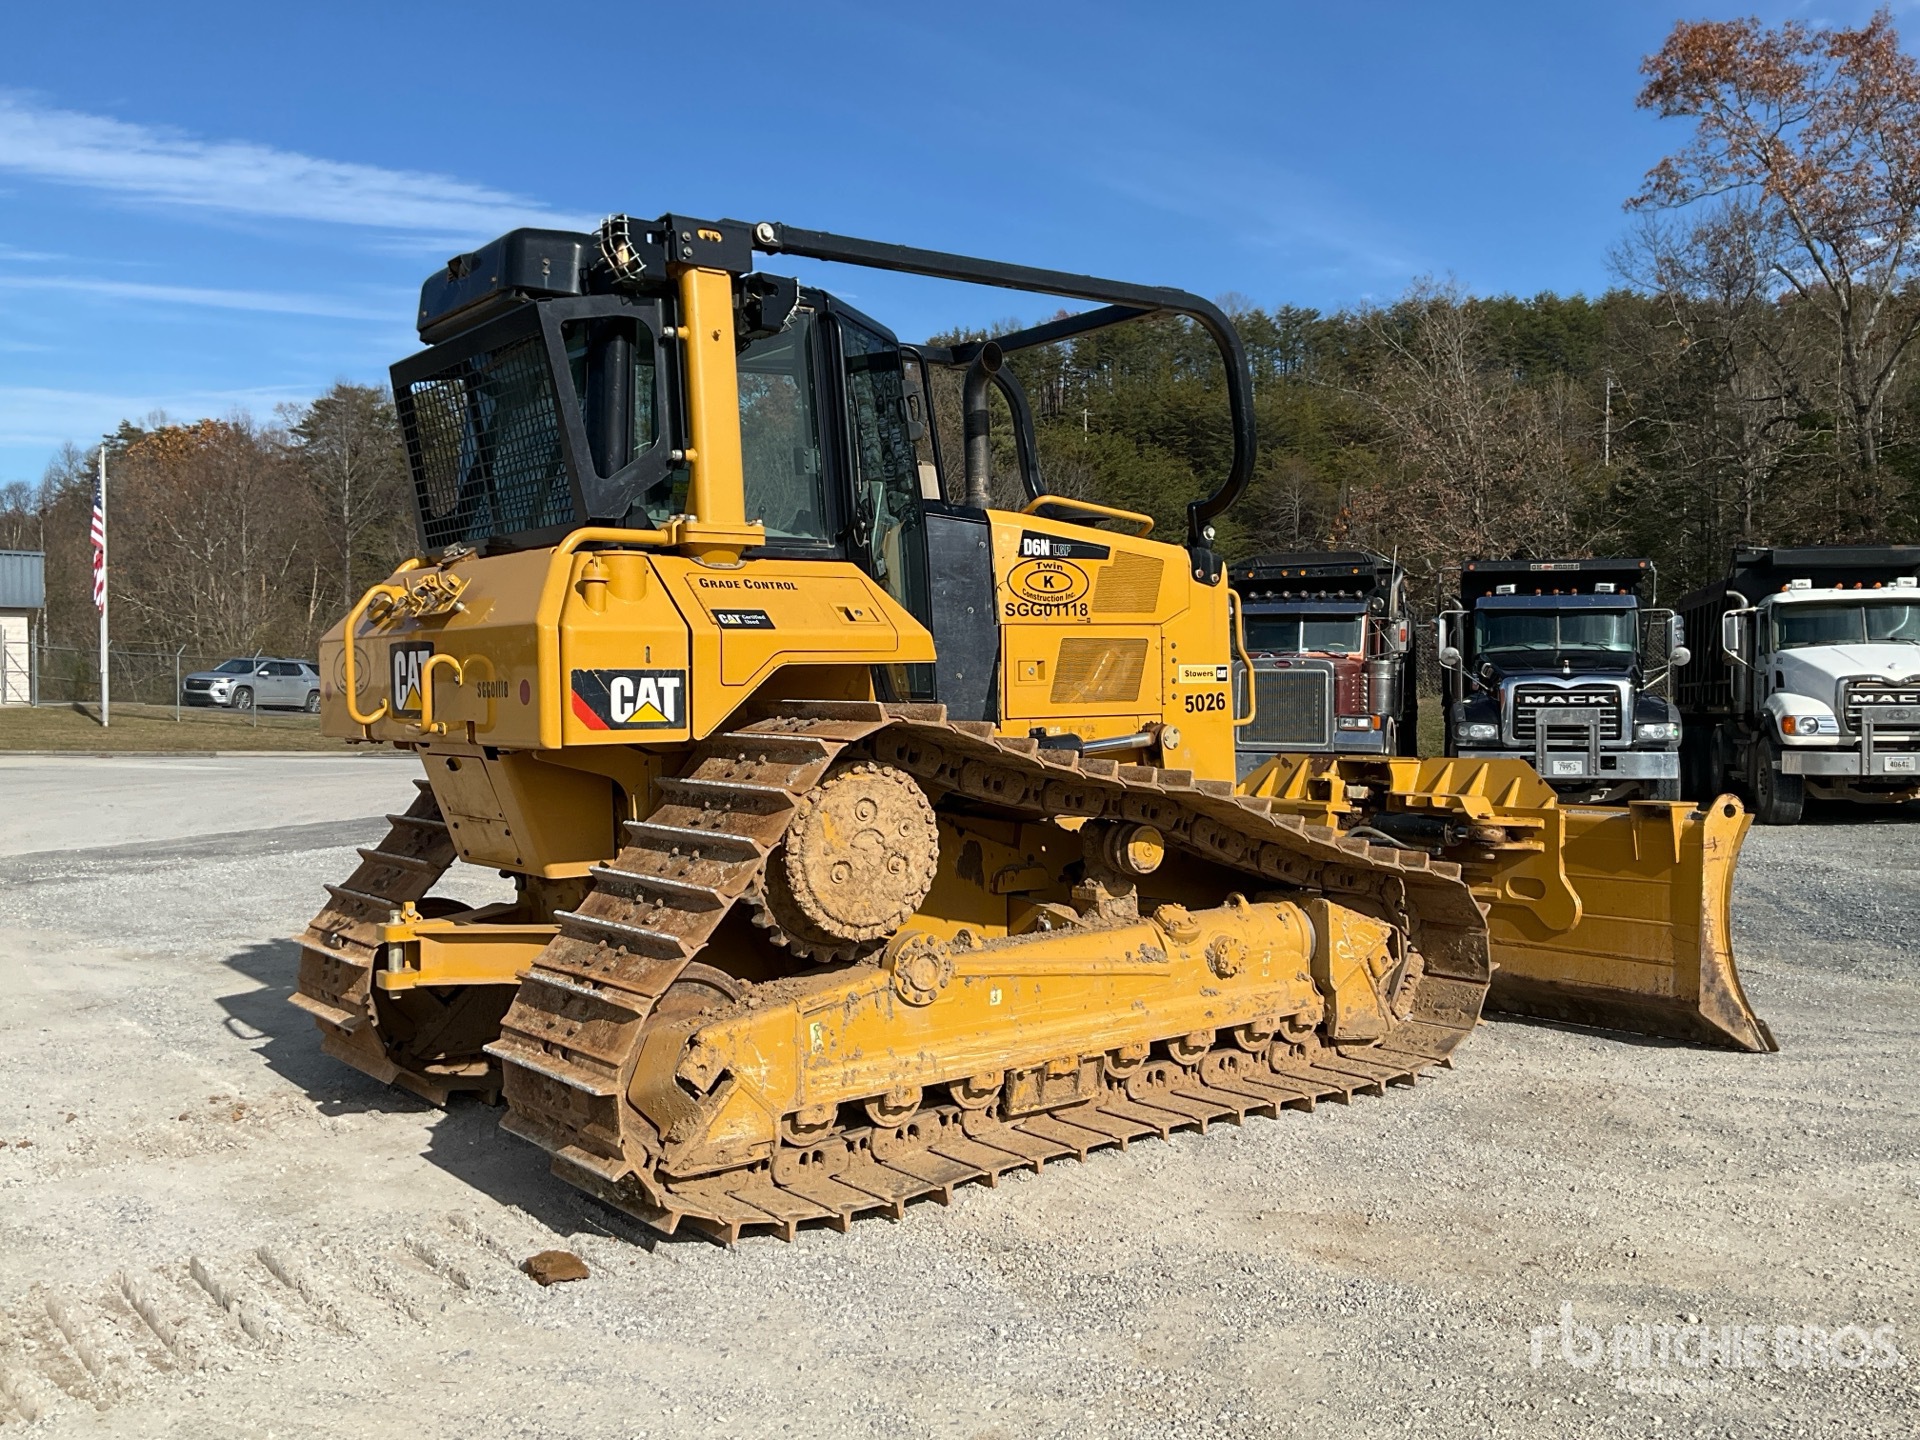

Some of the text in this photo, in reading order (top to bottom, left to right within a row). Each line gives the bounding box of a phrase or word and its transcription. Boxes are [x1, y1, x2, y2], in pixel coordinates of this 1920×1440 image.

[1023, 538, 1050, 556] D6N
[1036, 562, 1063, 571] Twin
[699, 578, 798, 590] GRADE CONTROL
[1043, 575, 1054, 588] K
[1022, 588, 1076, 602] Construction Inc.
[1005, 602, 1088, 617] SGG01118
[718, 614, 742, 624] CAT
[610, 676, 680, 723] CAT
[1185, 692, 1226, 713] 5026
[1524, 695, 1610, 704] MACK
